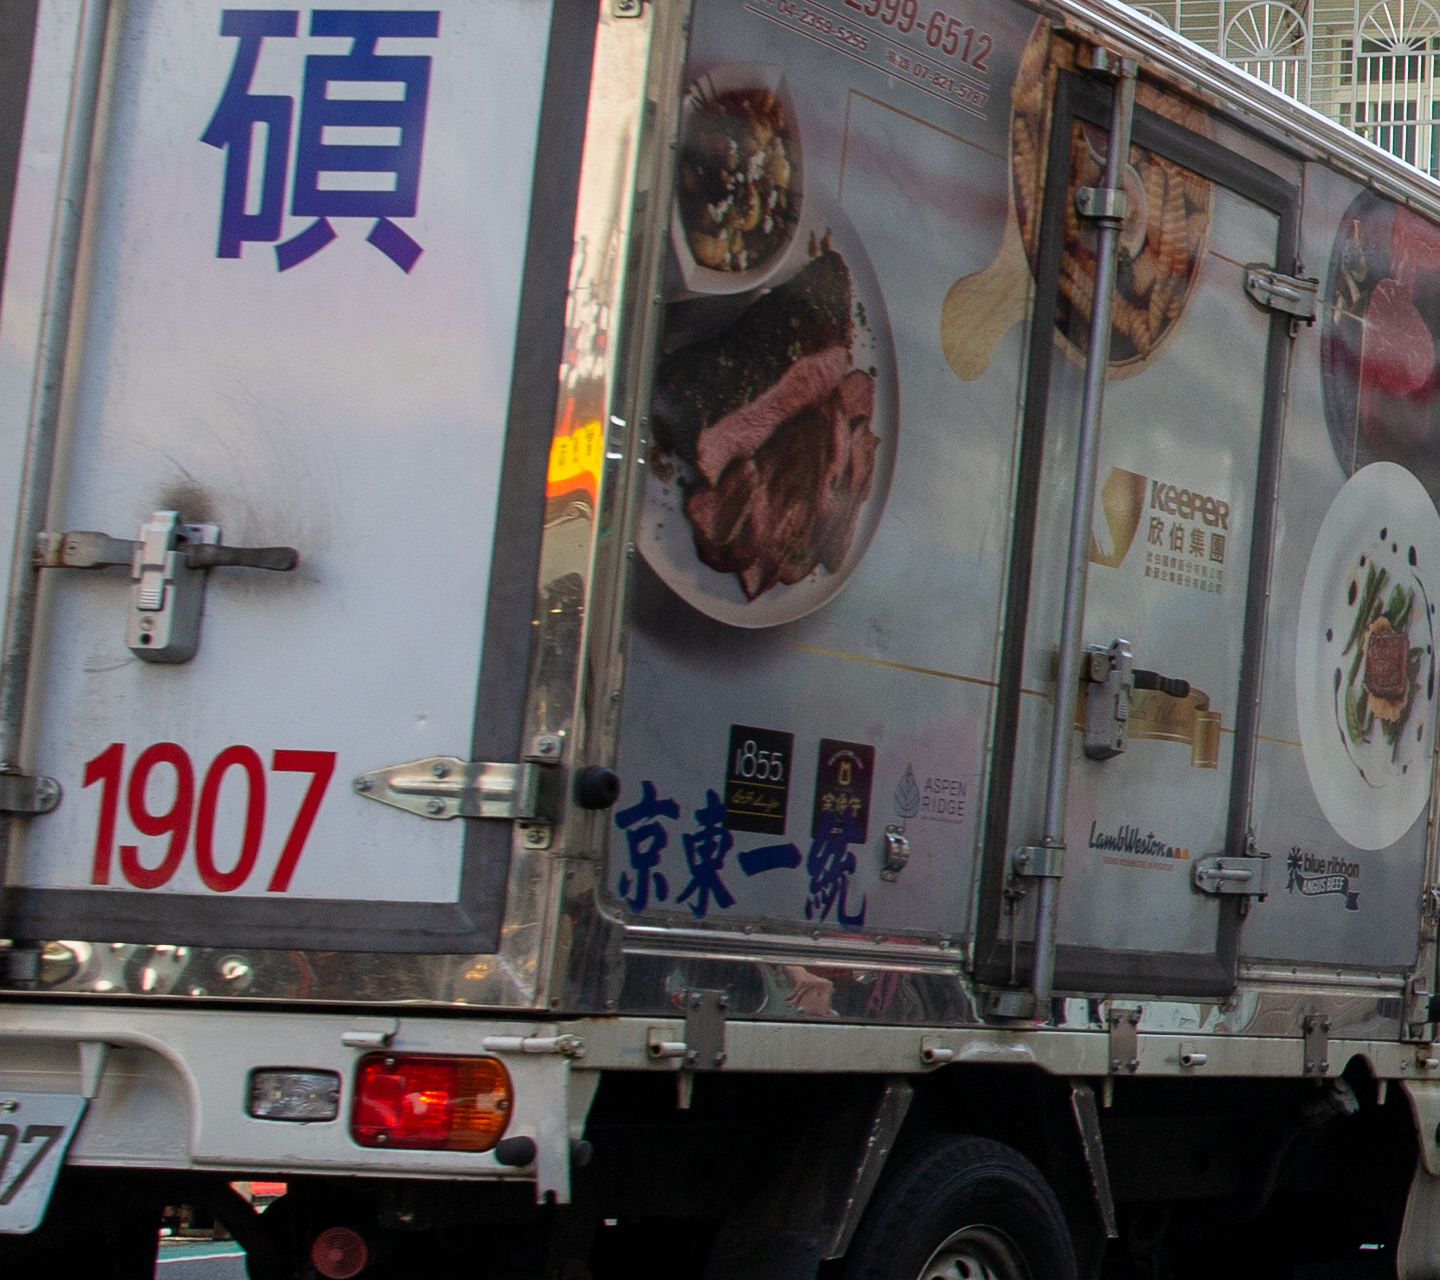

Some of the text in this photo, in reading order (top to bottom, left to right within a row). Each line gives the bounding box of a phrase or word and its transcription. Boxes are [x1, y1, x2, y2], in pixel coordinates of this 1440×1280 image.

[200, 8, 442, 275] 碩
[1147, 516, 1226, 565] 欣伯集團
[734, 739, 785, 782] 1855
[921, 795, 966, 817] RIDGE
[924, 777, 967, 797] ASPEN
[81, 741, 338, 893] 1907
[1303, 852, 1360, 879] blue ribbon
